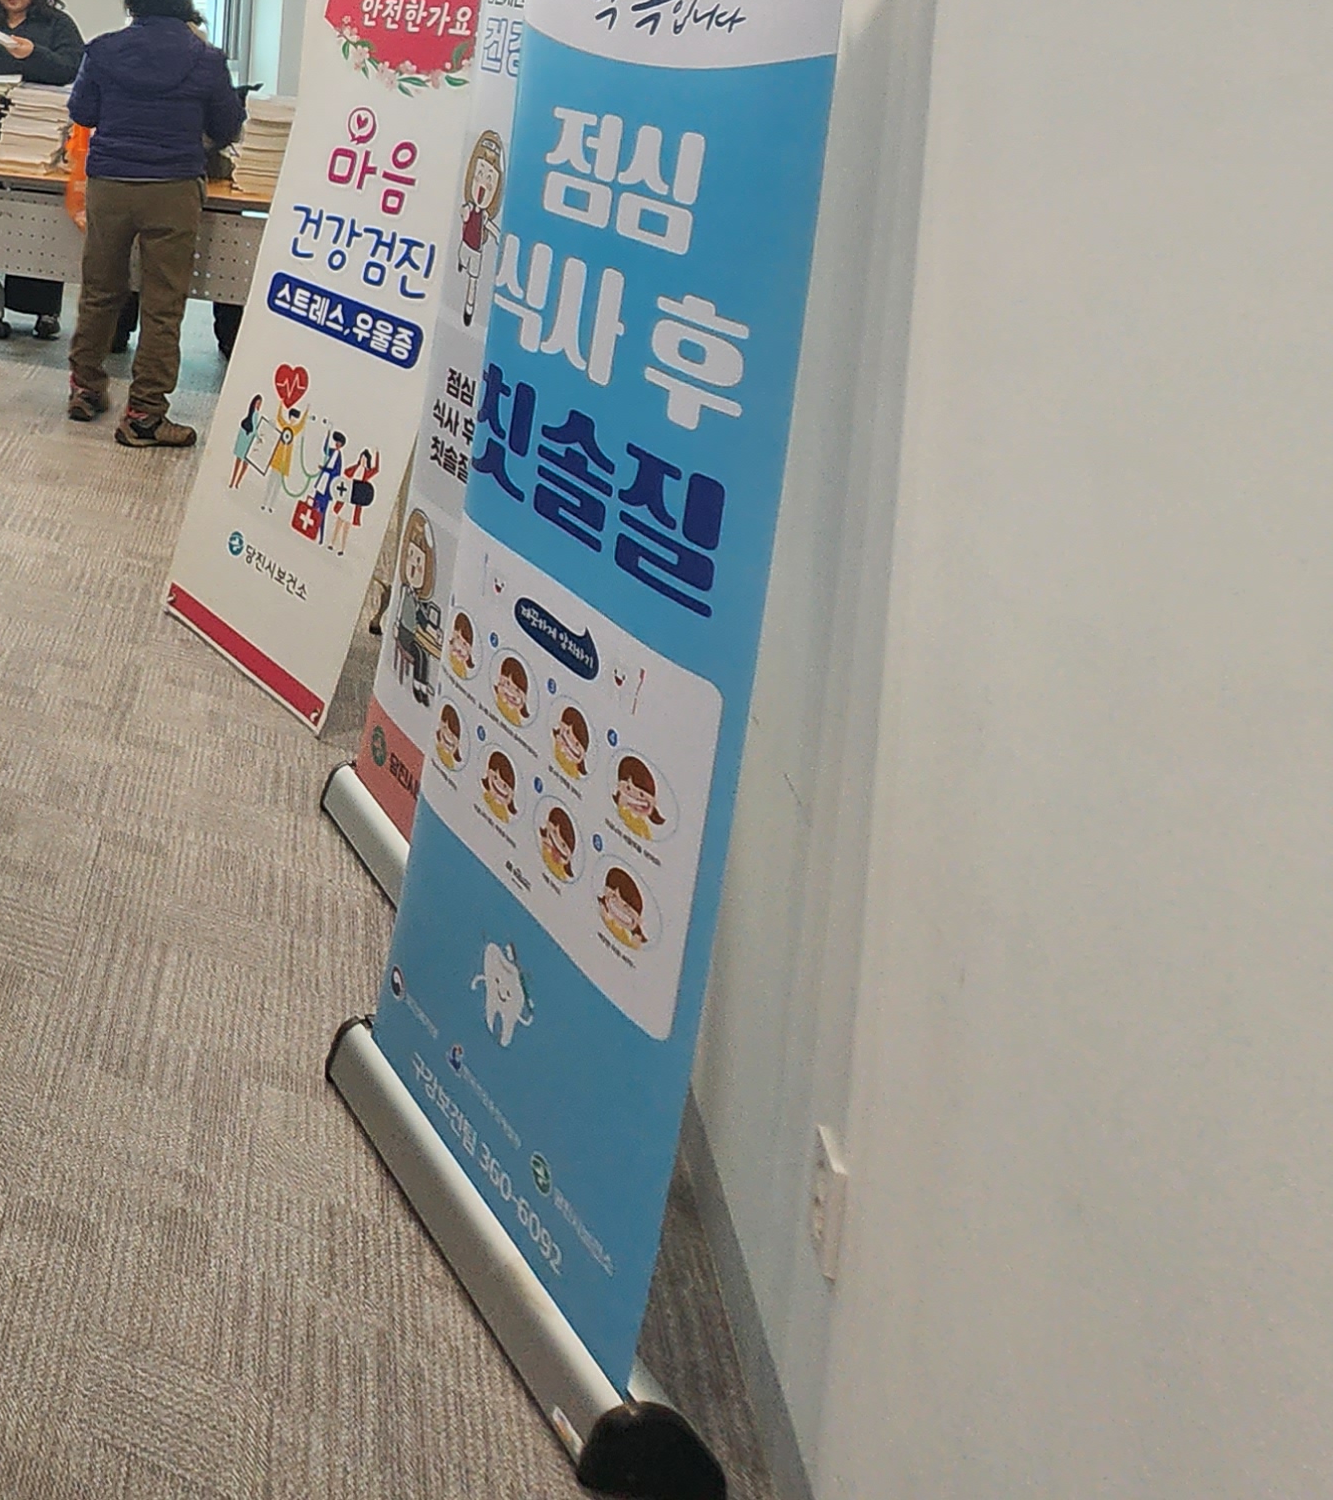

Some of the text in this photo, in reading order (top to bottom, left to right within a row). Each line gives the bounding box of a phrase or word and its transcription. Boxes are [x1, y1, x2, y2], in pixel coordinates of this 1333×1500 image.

[327, 141, 419, 216] 마음
[542, 106, 707, 256] 점심
[290, 204, 437, 300] 건강검진
[493, 233, 750, 431] 식사 후
[432, 398, 460, 438] 식사
[445, 367, 477, 408] 점심
[472, 362, 727, 619] 칫솔질
[245, 544, 307, 601] 당진시보건소
